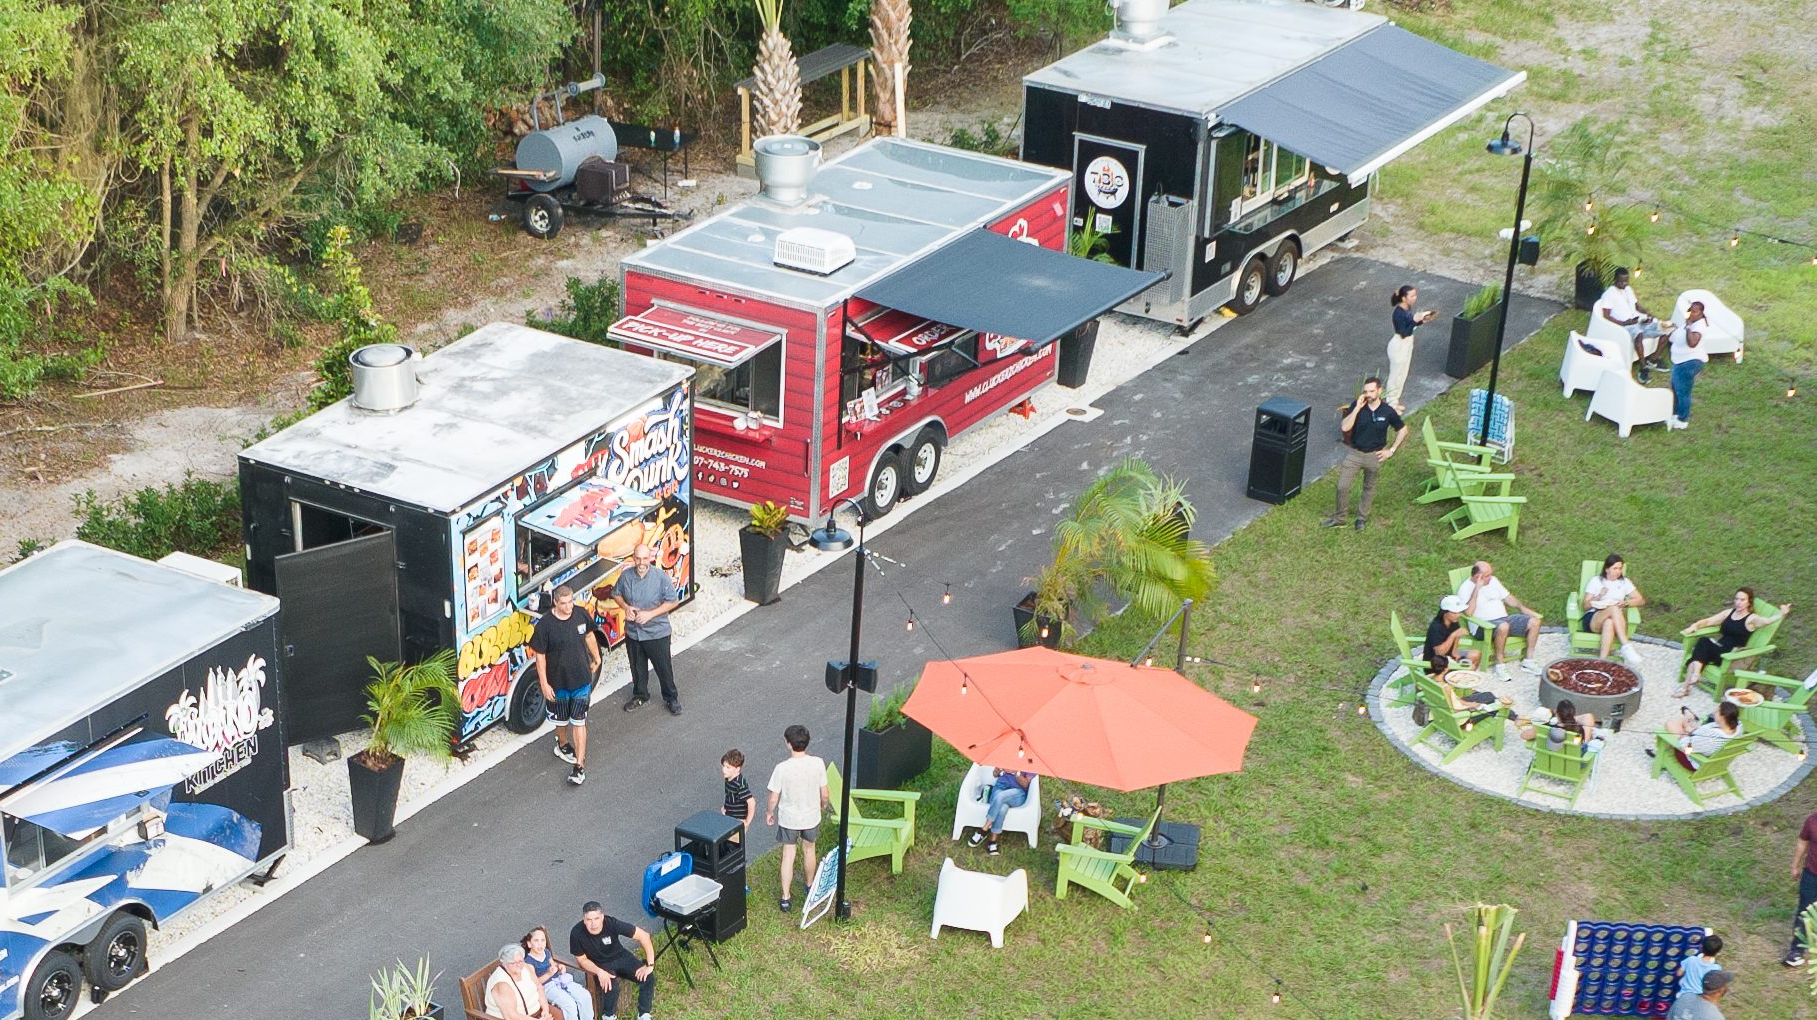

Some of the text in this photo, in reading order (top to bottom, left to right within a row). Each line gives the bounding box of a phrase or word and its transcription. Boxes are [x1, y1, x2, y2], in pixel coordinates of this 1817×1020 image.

[622, 320, 694, 344] PICK-UP
[692, 338, 740, 354] HERE
[607, 391, 684, 486] Smash
[693, 455, 750, 478] 07-743-7575
[184, 734, 258, 795] KITCHEN
